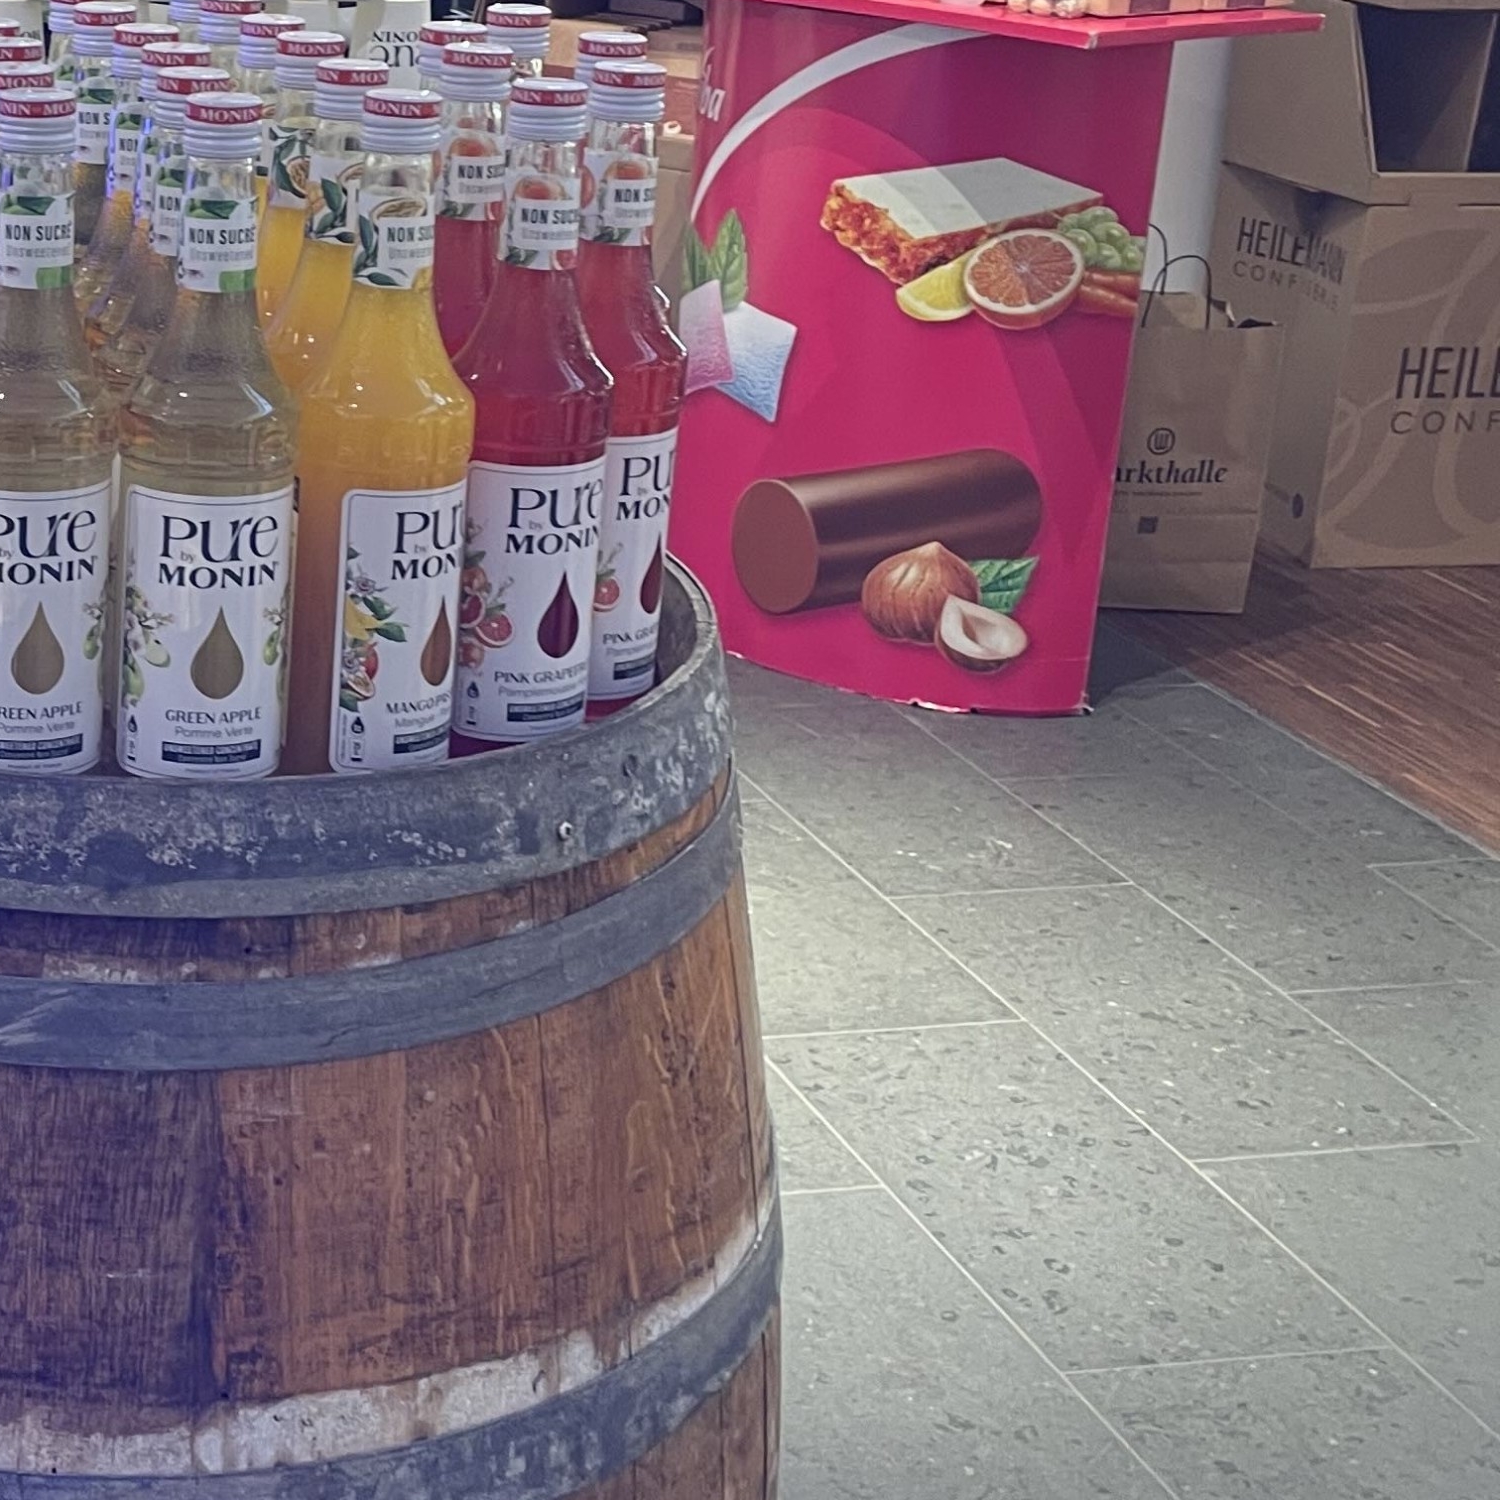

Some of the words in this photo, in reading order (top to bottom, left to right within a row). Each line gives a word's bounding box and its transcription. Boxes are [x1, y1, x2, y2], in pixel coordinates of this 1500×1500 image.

[287, 43, 342, 57] MONIN
[588, 44, 642, 56] MONIN
[452, 53, 508, 67] MONIN
[199, 106, 258, 124] MONIN
[458, 164, 483, 179] NON
[614, 188, 640, 203] NON
[521, 207, 548, 225] NON
[5, 224, 31, 241] NON
[189, 227, 215, 245] NON
[387, 226, 415, 242] NON
[160, 514, 279, 564] Pure
[180, 550, 197, 564] by
[158, 560, 278, 589] MONIN
[494, 670, 530, 684] PINK
[40, 701, 83, 719] APPLE
[165, 709, 216, 724] GREEN
[219, 706, 262, 724] APPLE
[174, 725, 222, 738] Pomme
